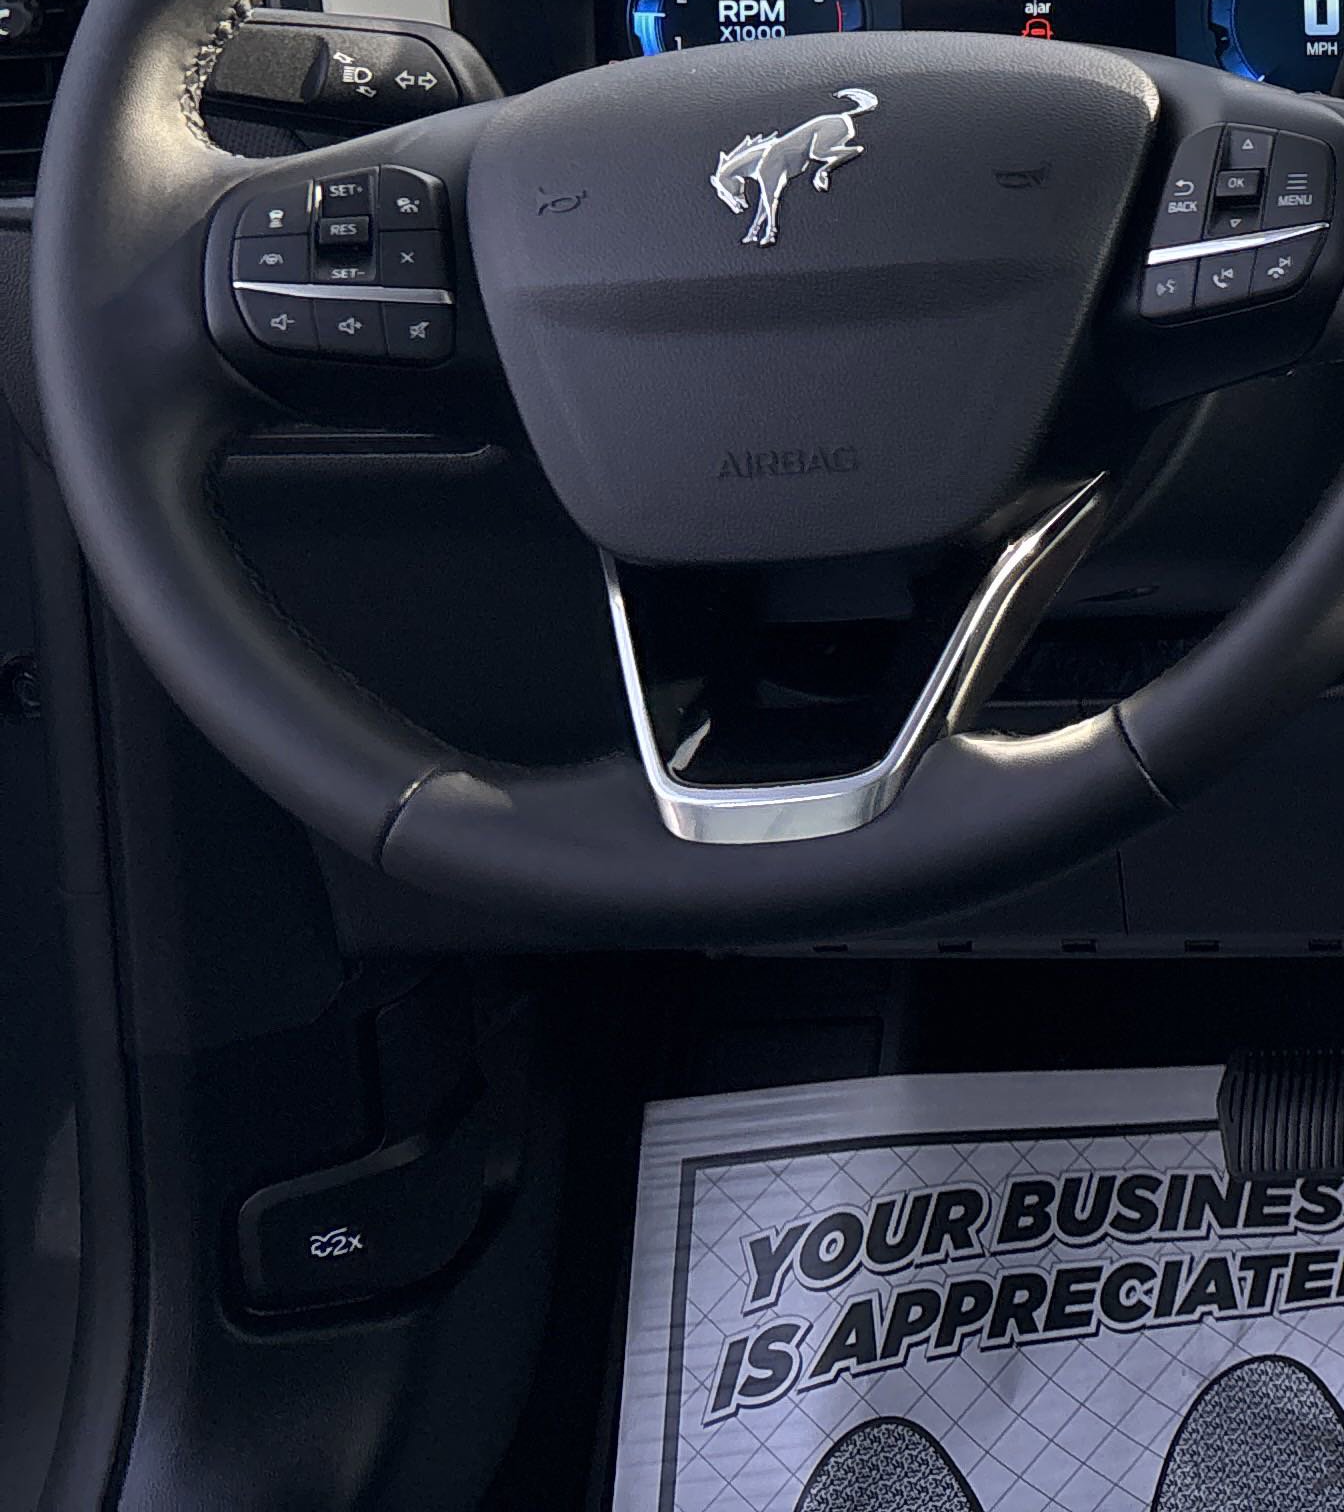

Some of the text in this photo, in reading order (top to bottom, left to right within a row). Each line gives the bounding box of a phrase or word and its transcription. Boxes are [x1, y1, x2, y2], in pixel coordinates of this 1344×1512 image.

[718, 0, 786, 23] RPM
[1024, 0, 1052, 15] ajar
[719, 25, 786, 42] X1000
[1305, 41, 1339, 56] MPH
[1227, 177, 1245, 189] OK
[1167, 201, 1198, 213] BACK
[1277, 194, 1313, 207] MENU
[329, 224, 357, 236] RES
[718, 445, 859, 478] AIRBAG
[740, 1185, 993, 1318] YOUR
[704, 1316, 810, 1424] IS
